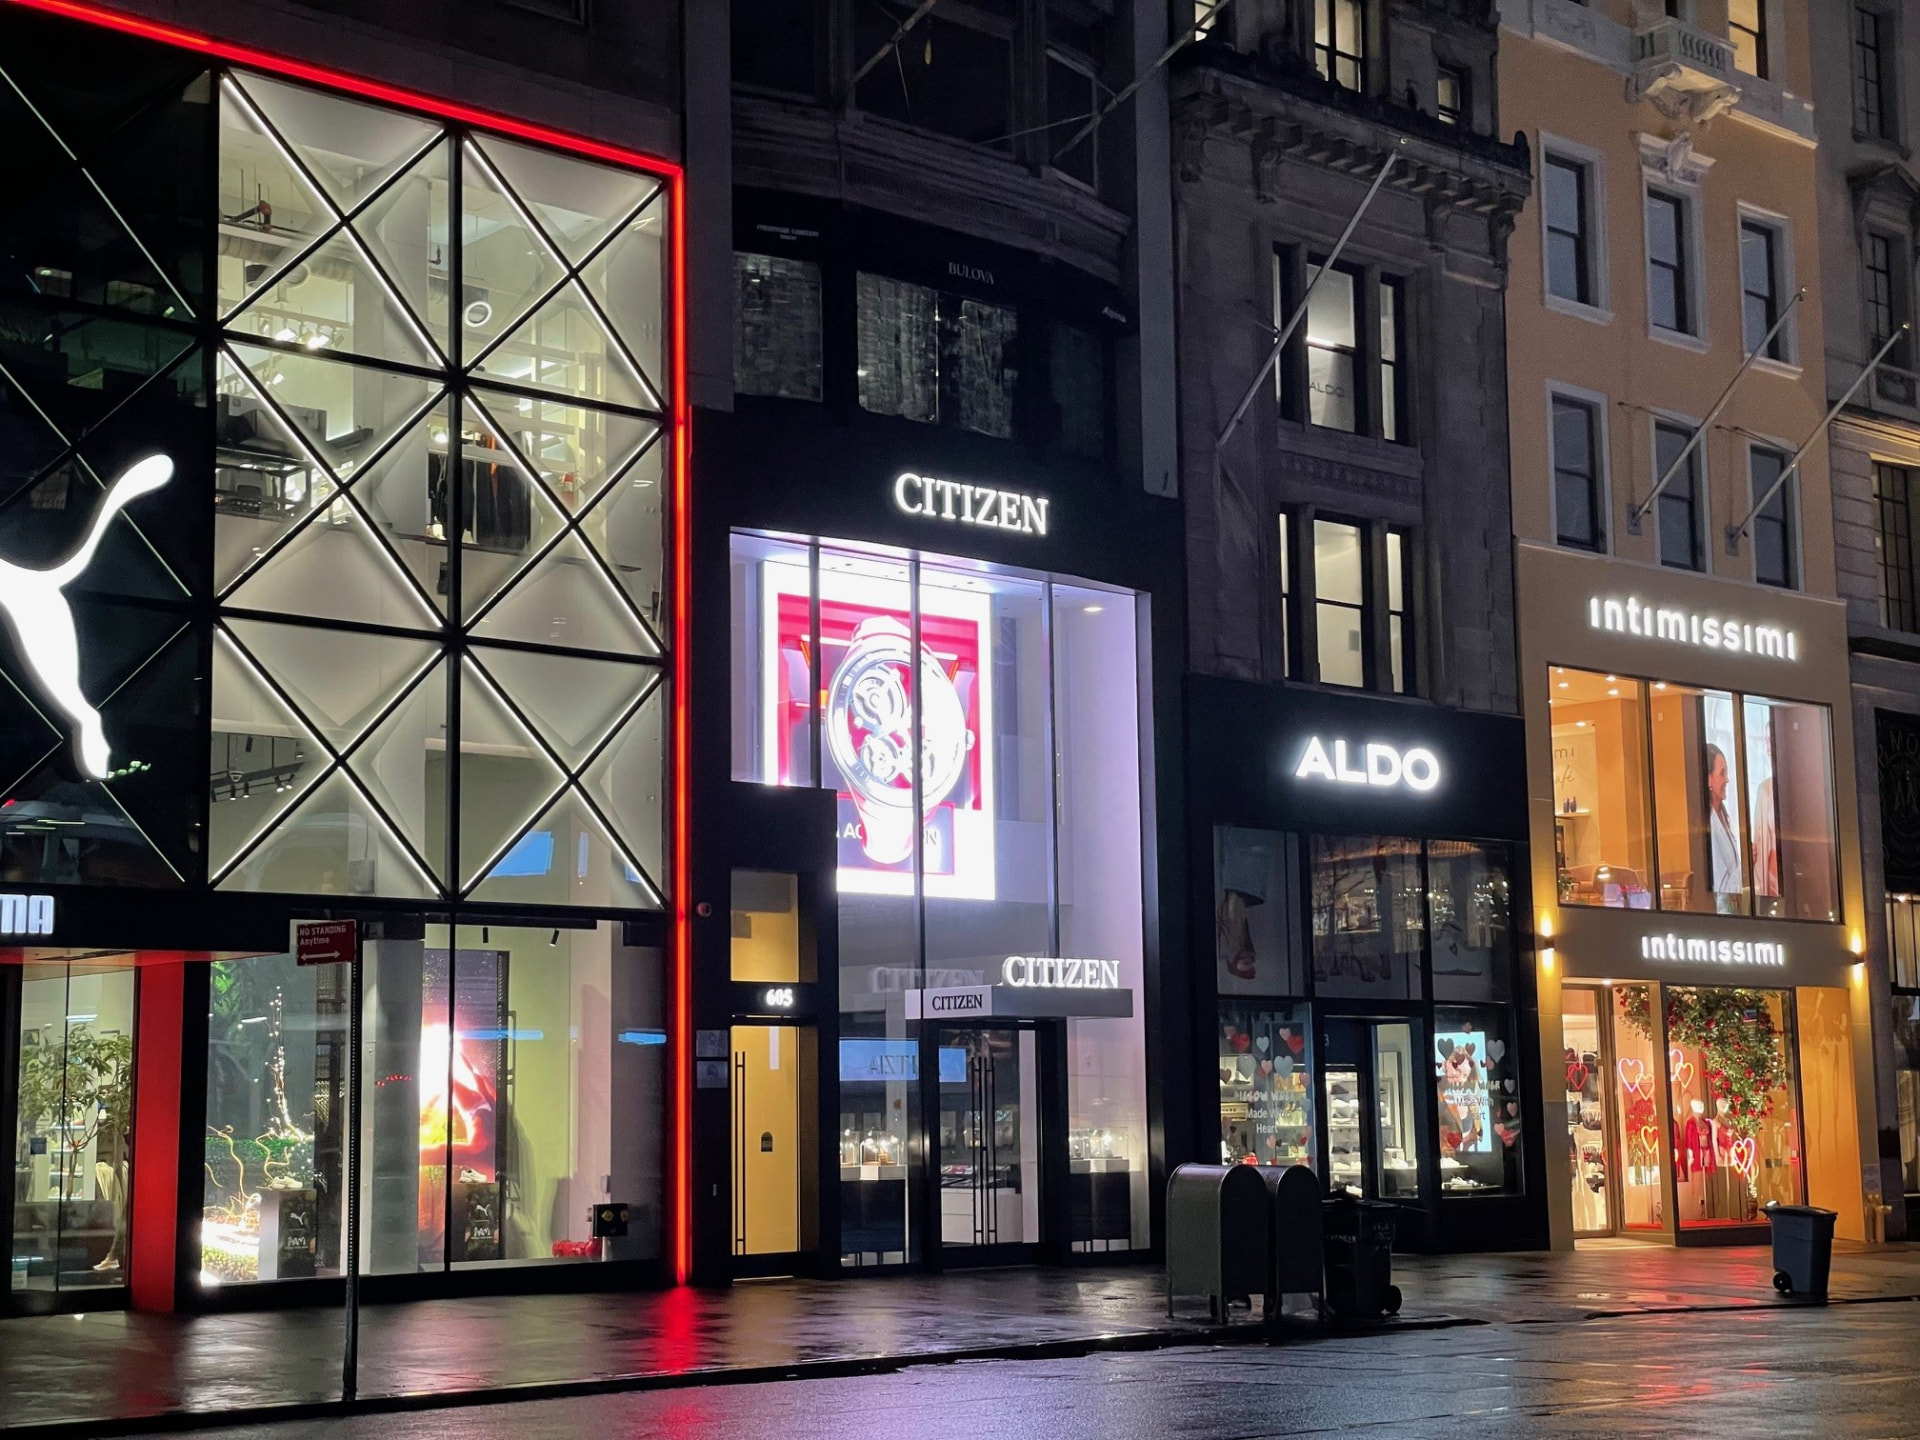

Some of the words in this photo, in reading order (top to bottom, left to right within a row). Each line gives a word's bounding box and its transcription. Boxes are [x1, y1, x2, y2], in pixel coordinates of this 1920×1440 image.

[948, 262, 995, 286] BULOVA
[1309, 381, 1346, 398] ALDO
[895, 472, 1049, 535] CITIZEN
[1590, 596, 1796, 661] intimissimi
[1295, 736, 1440, 791] ALDO
[300, 928, 310, 937] NO
[311, 924, 347, 936] STANDING
[300, 935, 330, 947] Anytime
[1641, 933, 1784, 967] intimissimi
[1003, 956, 1121, 989] CITIZEN
[766, 987, 794, 1008] 605
[931, 994, 983, 1012] CITIZEN
[1246, 1108, 1269, 1119] Made
[1256, 1123, 1279, 1134] Heart
